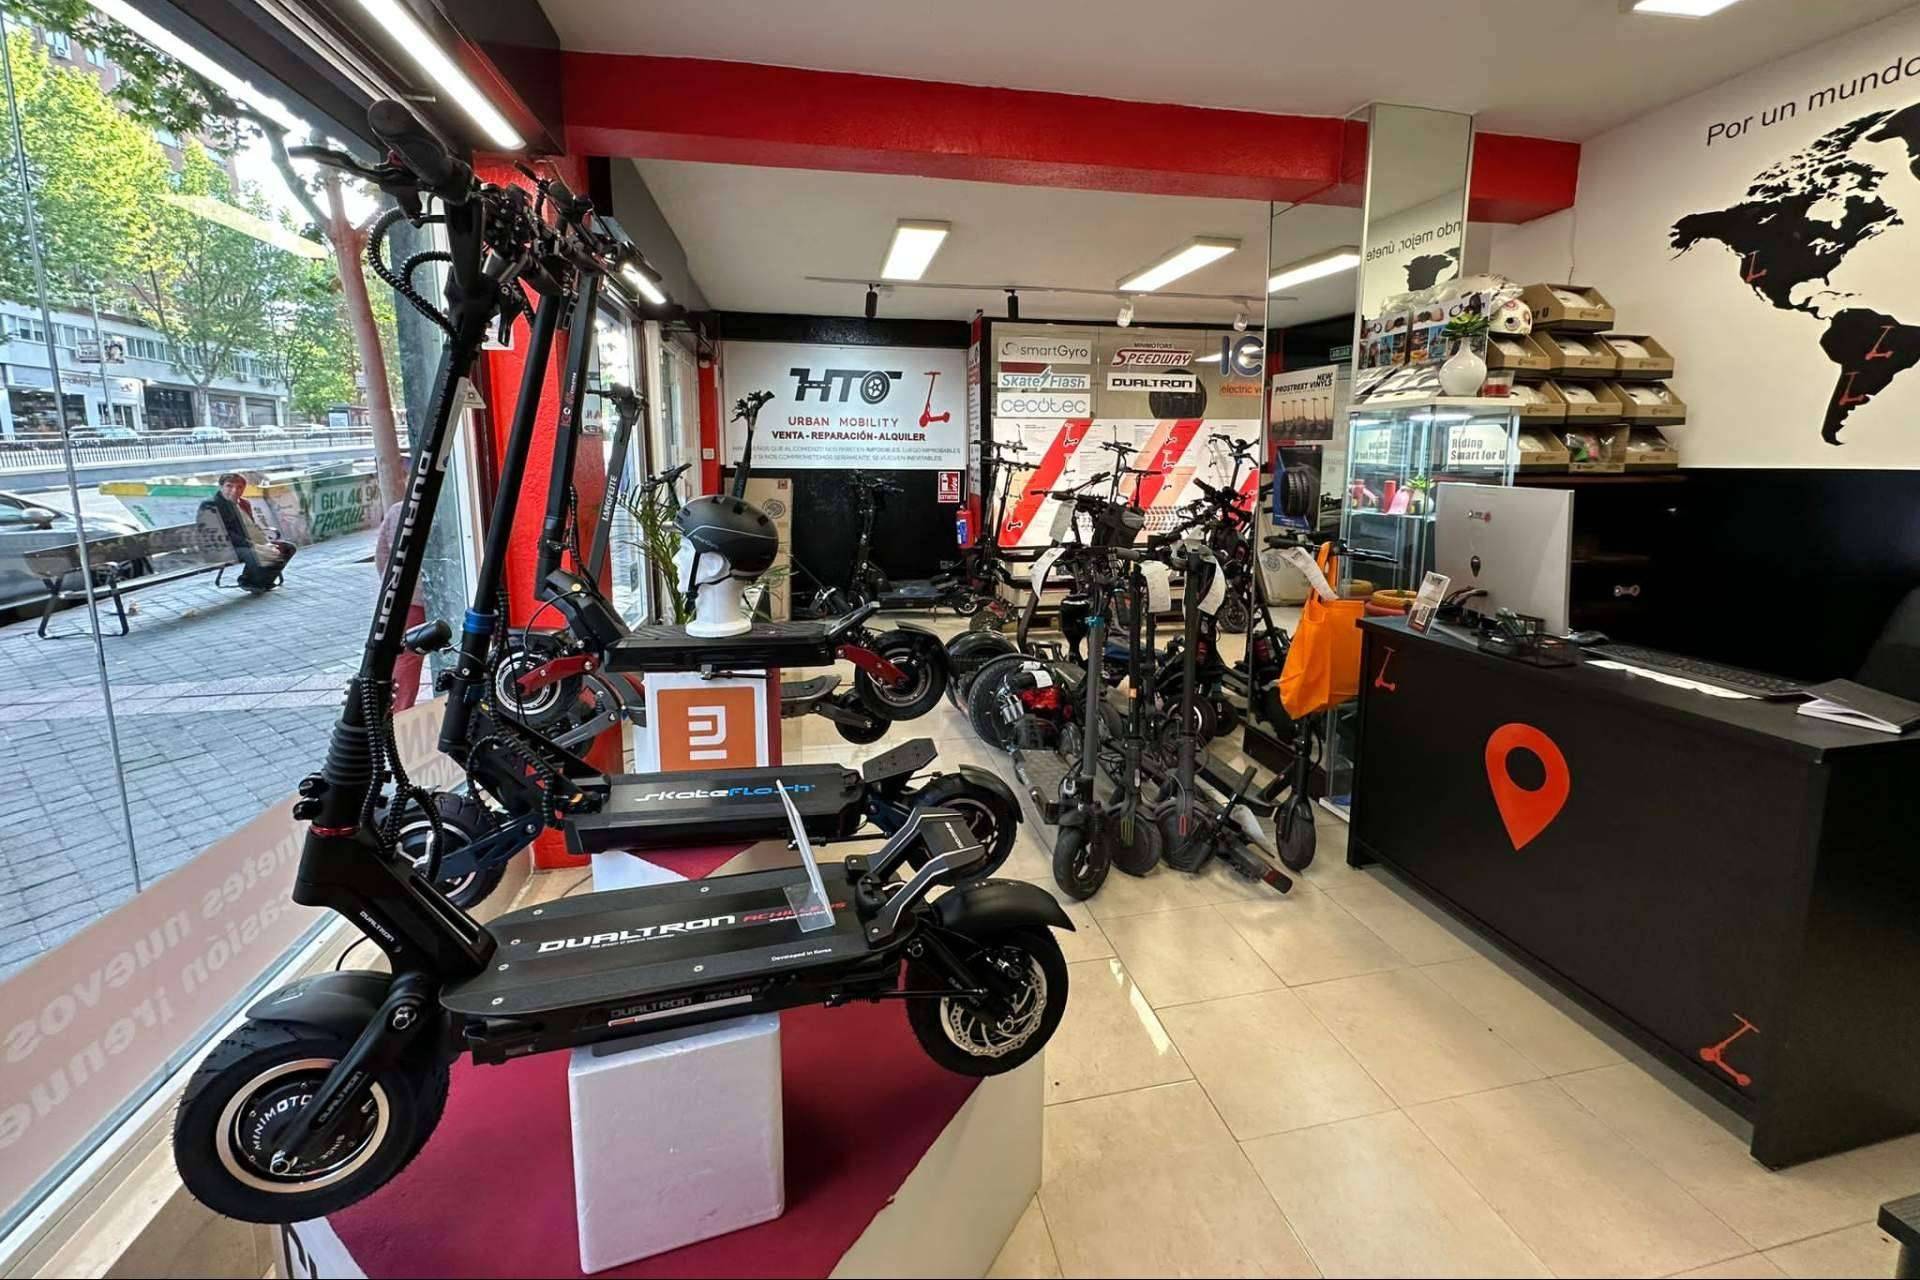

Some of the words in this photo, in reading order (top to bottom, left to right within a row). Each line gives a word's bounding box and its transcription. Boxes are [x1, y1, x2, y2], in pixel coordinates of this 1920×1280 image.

[1707, 116, 1753, 146] Por
[1762, 101, 1796, 127] un
[1020, 344, 1088, 359] smartGyro
[1112, 349, 1192, 366] SPEEDWAY
[1112, 378, 1193, 389] DUALTRON
[1001, 397, 1086, 413] cecotec
[788, 416, 830, 426] URBAN
[839, 417, 899, 428] MOBILITY
[771, 431, 804, 440] VENTA
[811, 430, 874, 441] REPARACIÓN
[879, 432, 926, 442] ALQUILER
[1452, 438, 1483, 449] Riding
[1451, 451, 1480, 461] Smart
[1482, 450, 1498, 460] for
[601, 474, 618, 521] LANGFEITE
[374, 450, 431, 641] DUALTRON
[360, 911, 395, 942] DUALTRON
[538, 914, 736, 953] DUALTRON
[610, 997, 692, 1017] DUALTRON
[253, 1094, 312, 1151] MINIMOTO
